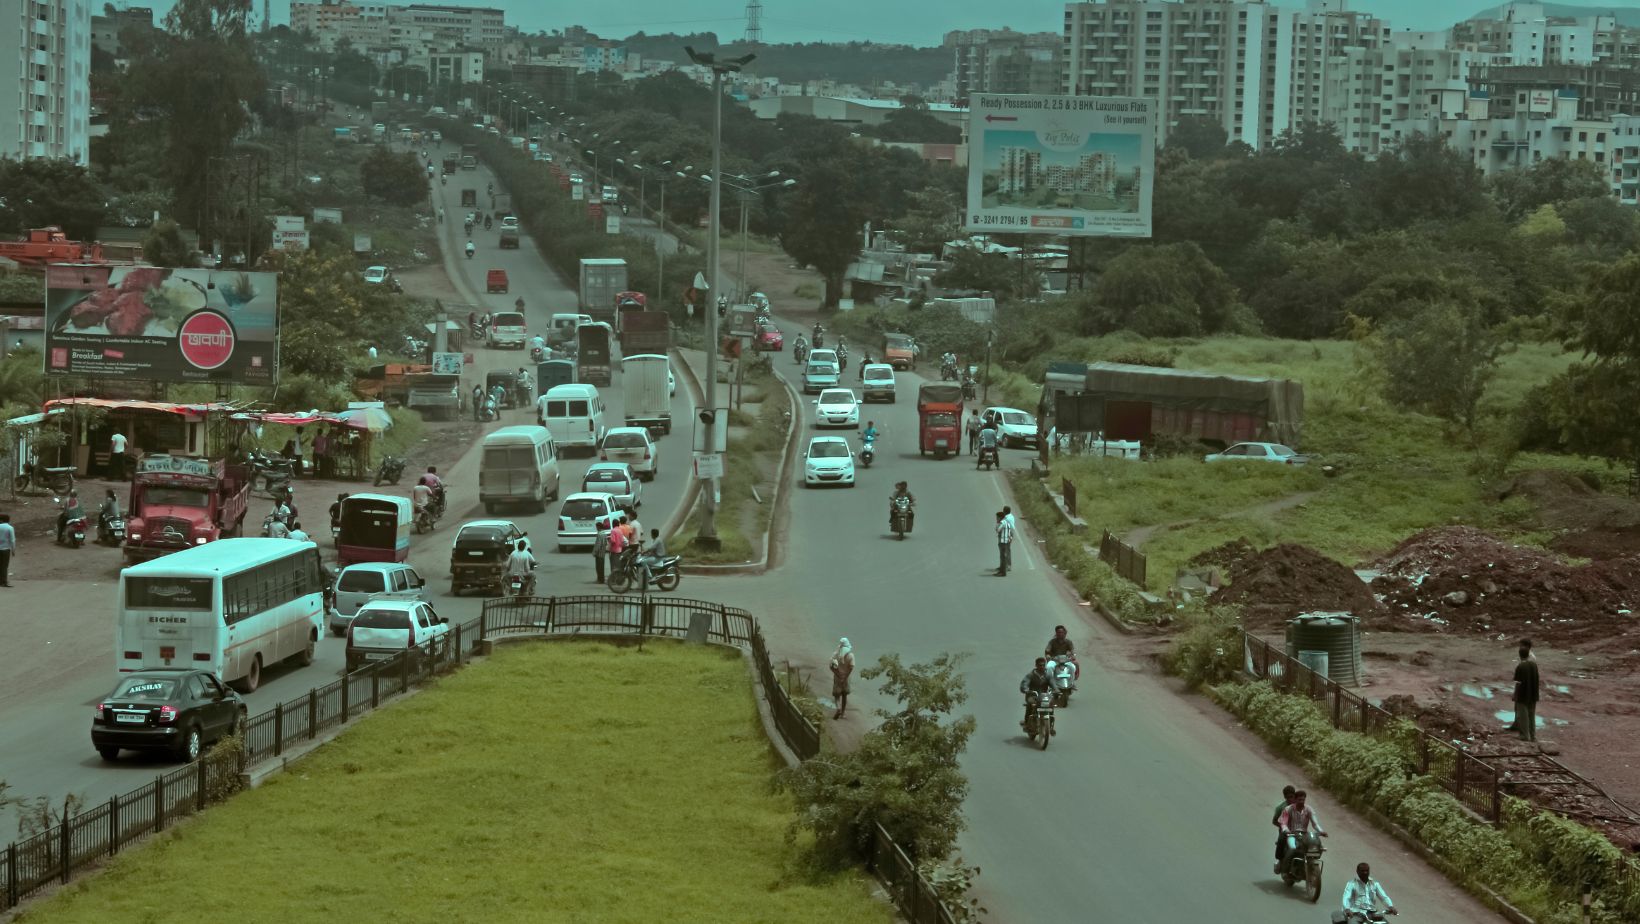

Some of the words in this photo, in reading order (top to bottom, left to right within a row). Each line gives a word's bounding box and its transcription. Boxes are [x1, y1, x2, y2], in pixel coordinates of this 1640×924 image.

[981, 97, 1002, 110] Ready
[1004, 98, 1042, 109] Possession
[1052, 99, 1063, 110] 2.5
[1065, 100, 1071, 110] &
[1072, 100, 1077, 110] 3
[1079, 100, 1094, 111] BHK
[1095, 101, 1128, 112] Luxurious
[1130, 102, 1148, 112] Flats
[1104, 114, 1117, 124] (See
[1122, 115, 1147, 125] yourself)
[72, 352, 103, 360] Breakfast
[128, 683, 163, 694] AKSHAY
